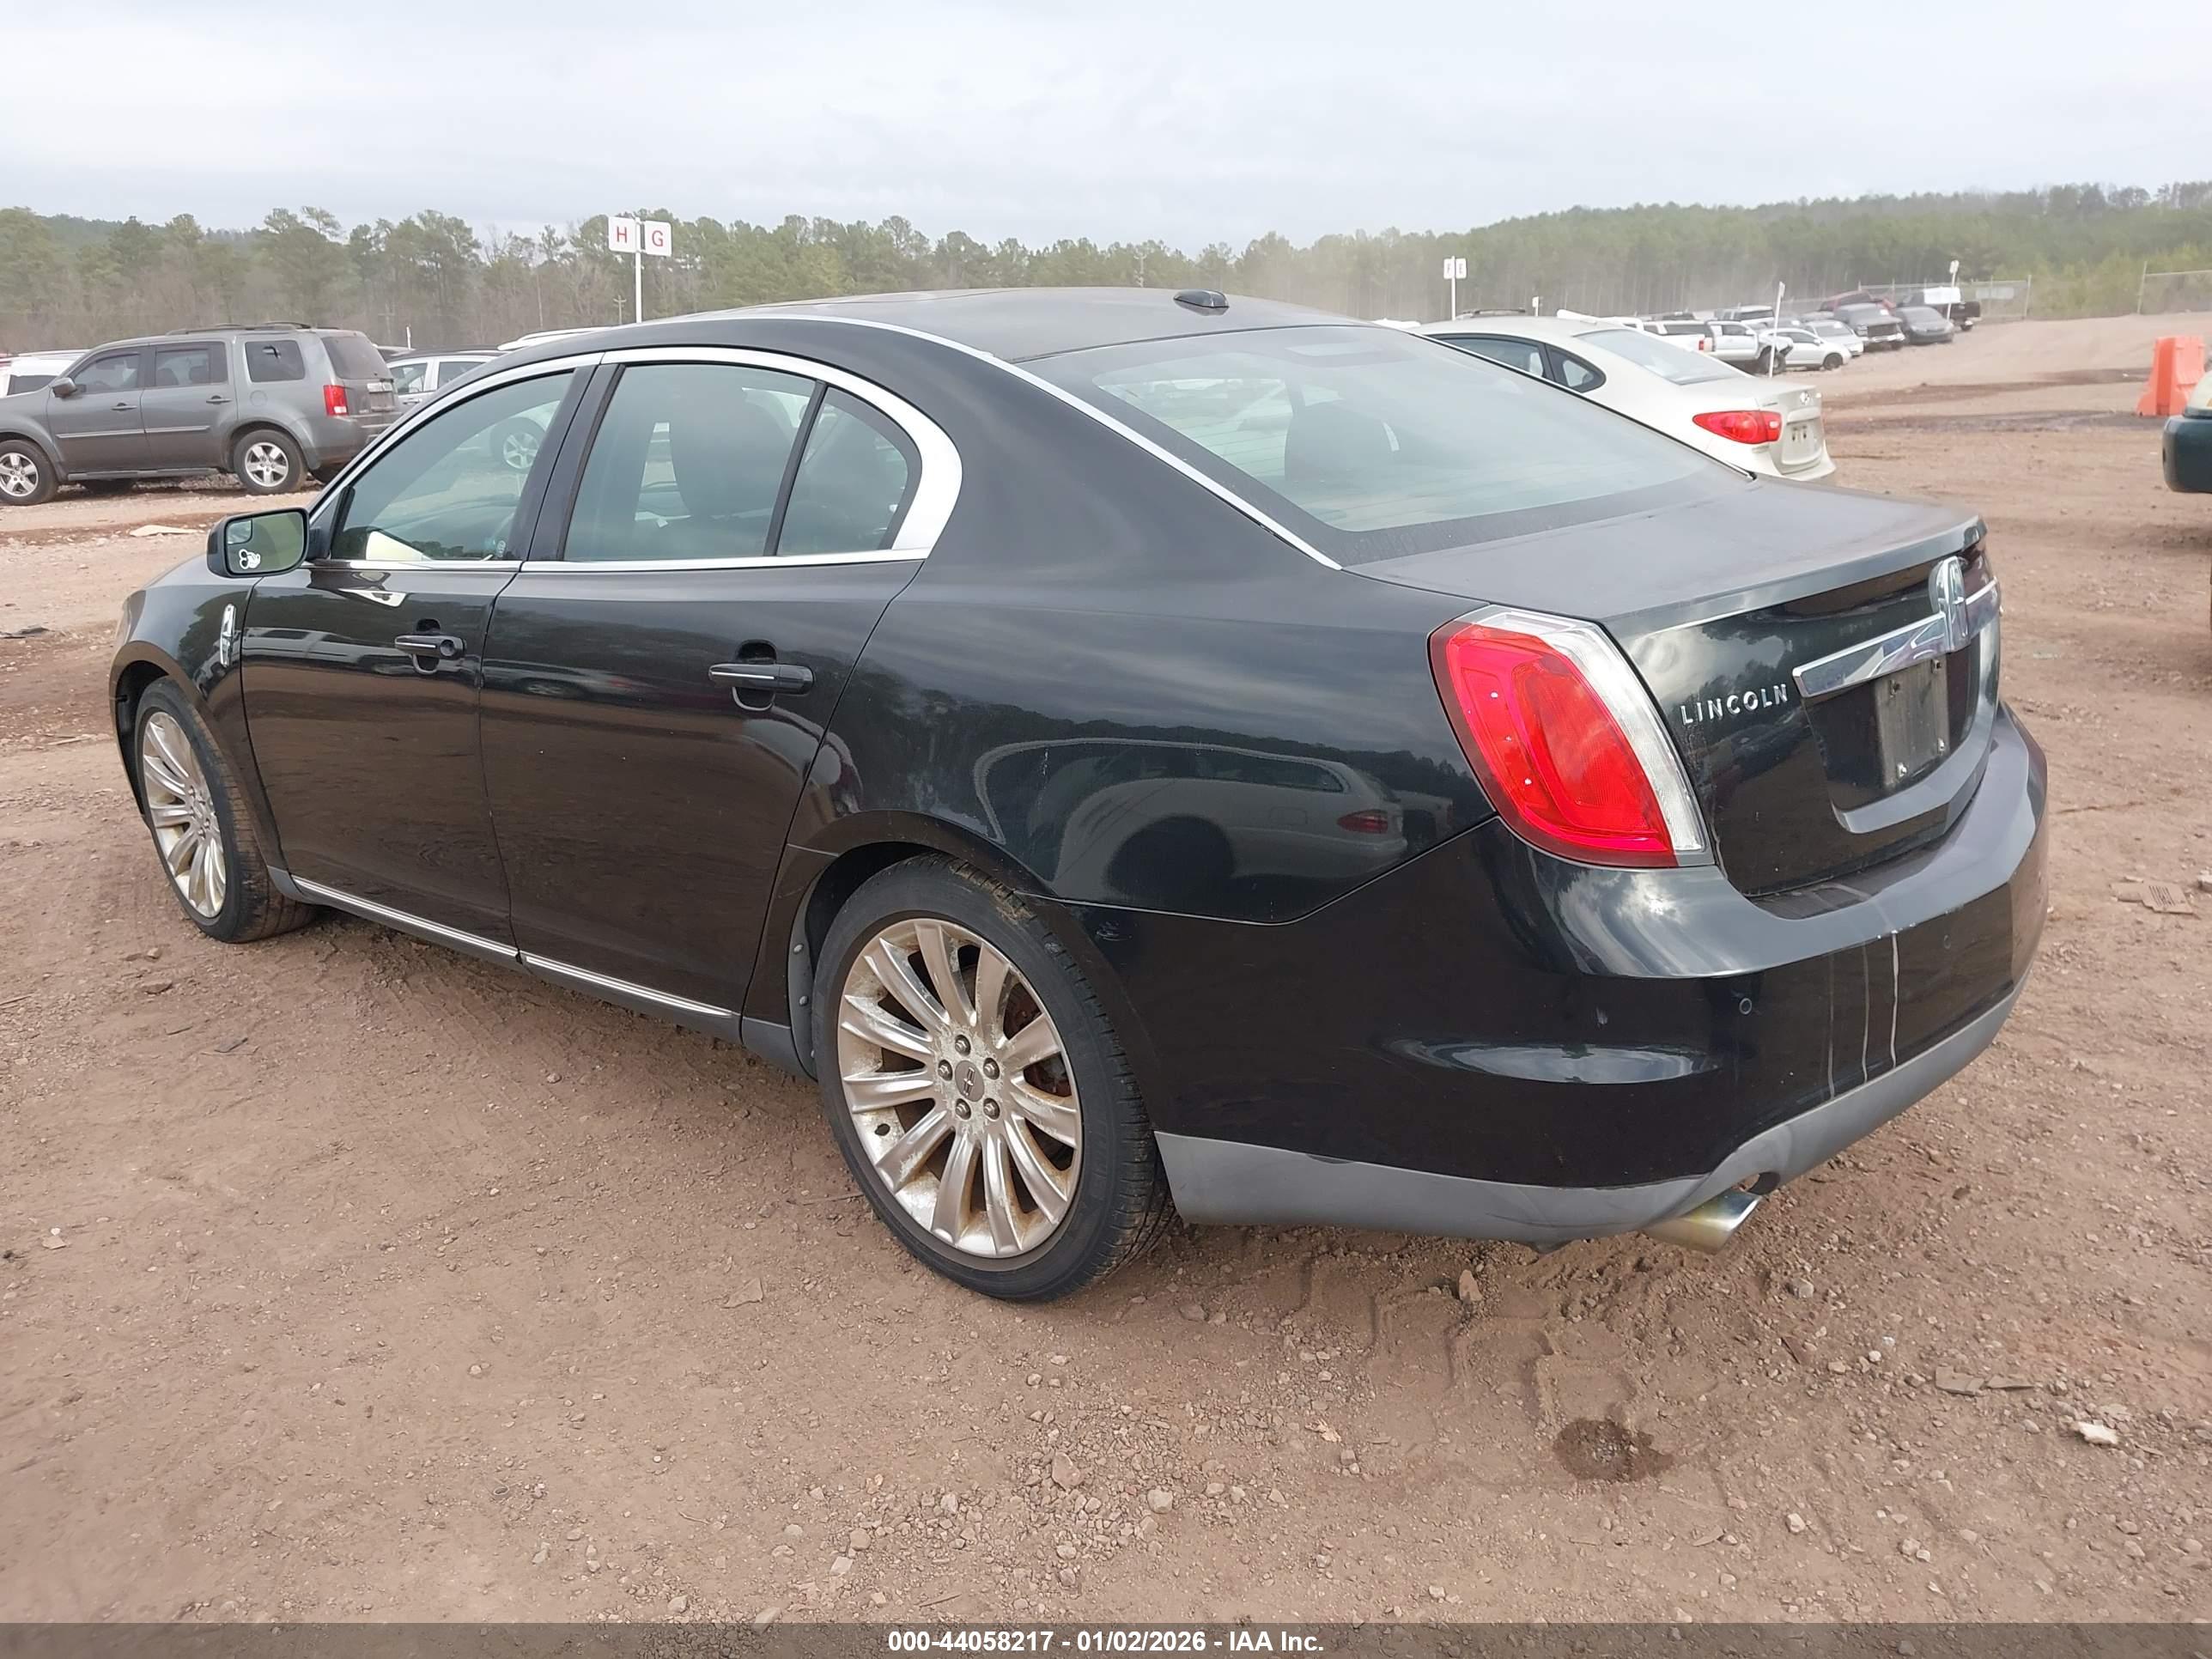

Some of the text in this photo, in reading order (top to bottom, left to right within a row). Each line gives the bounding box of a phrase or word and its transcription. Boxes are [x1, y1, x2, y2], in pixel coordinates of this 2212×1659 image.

[616, 226, 628, 244] H
[651, 229, 665, 247] G
[1680, 684, 1788, 726] LINCOLN
